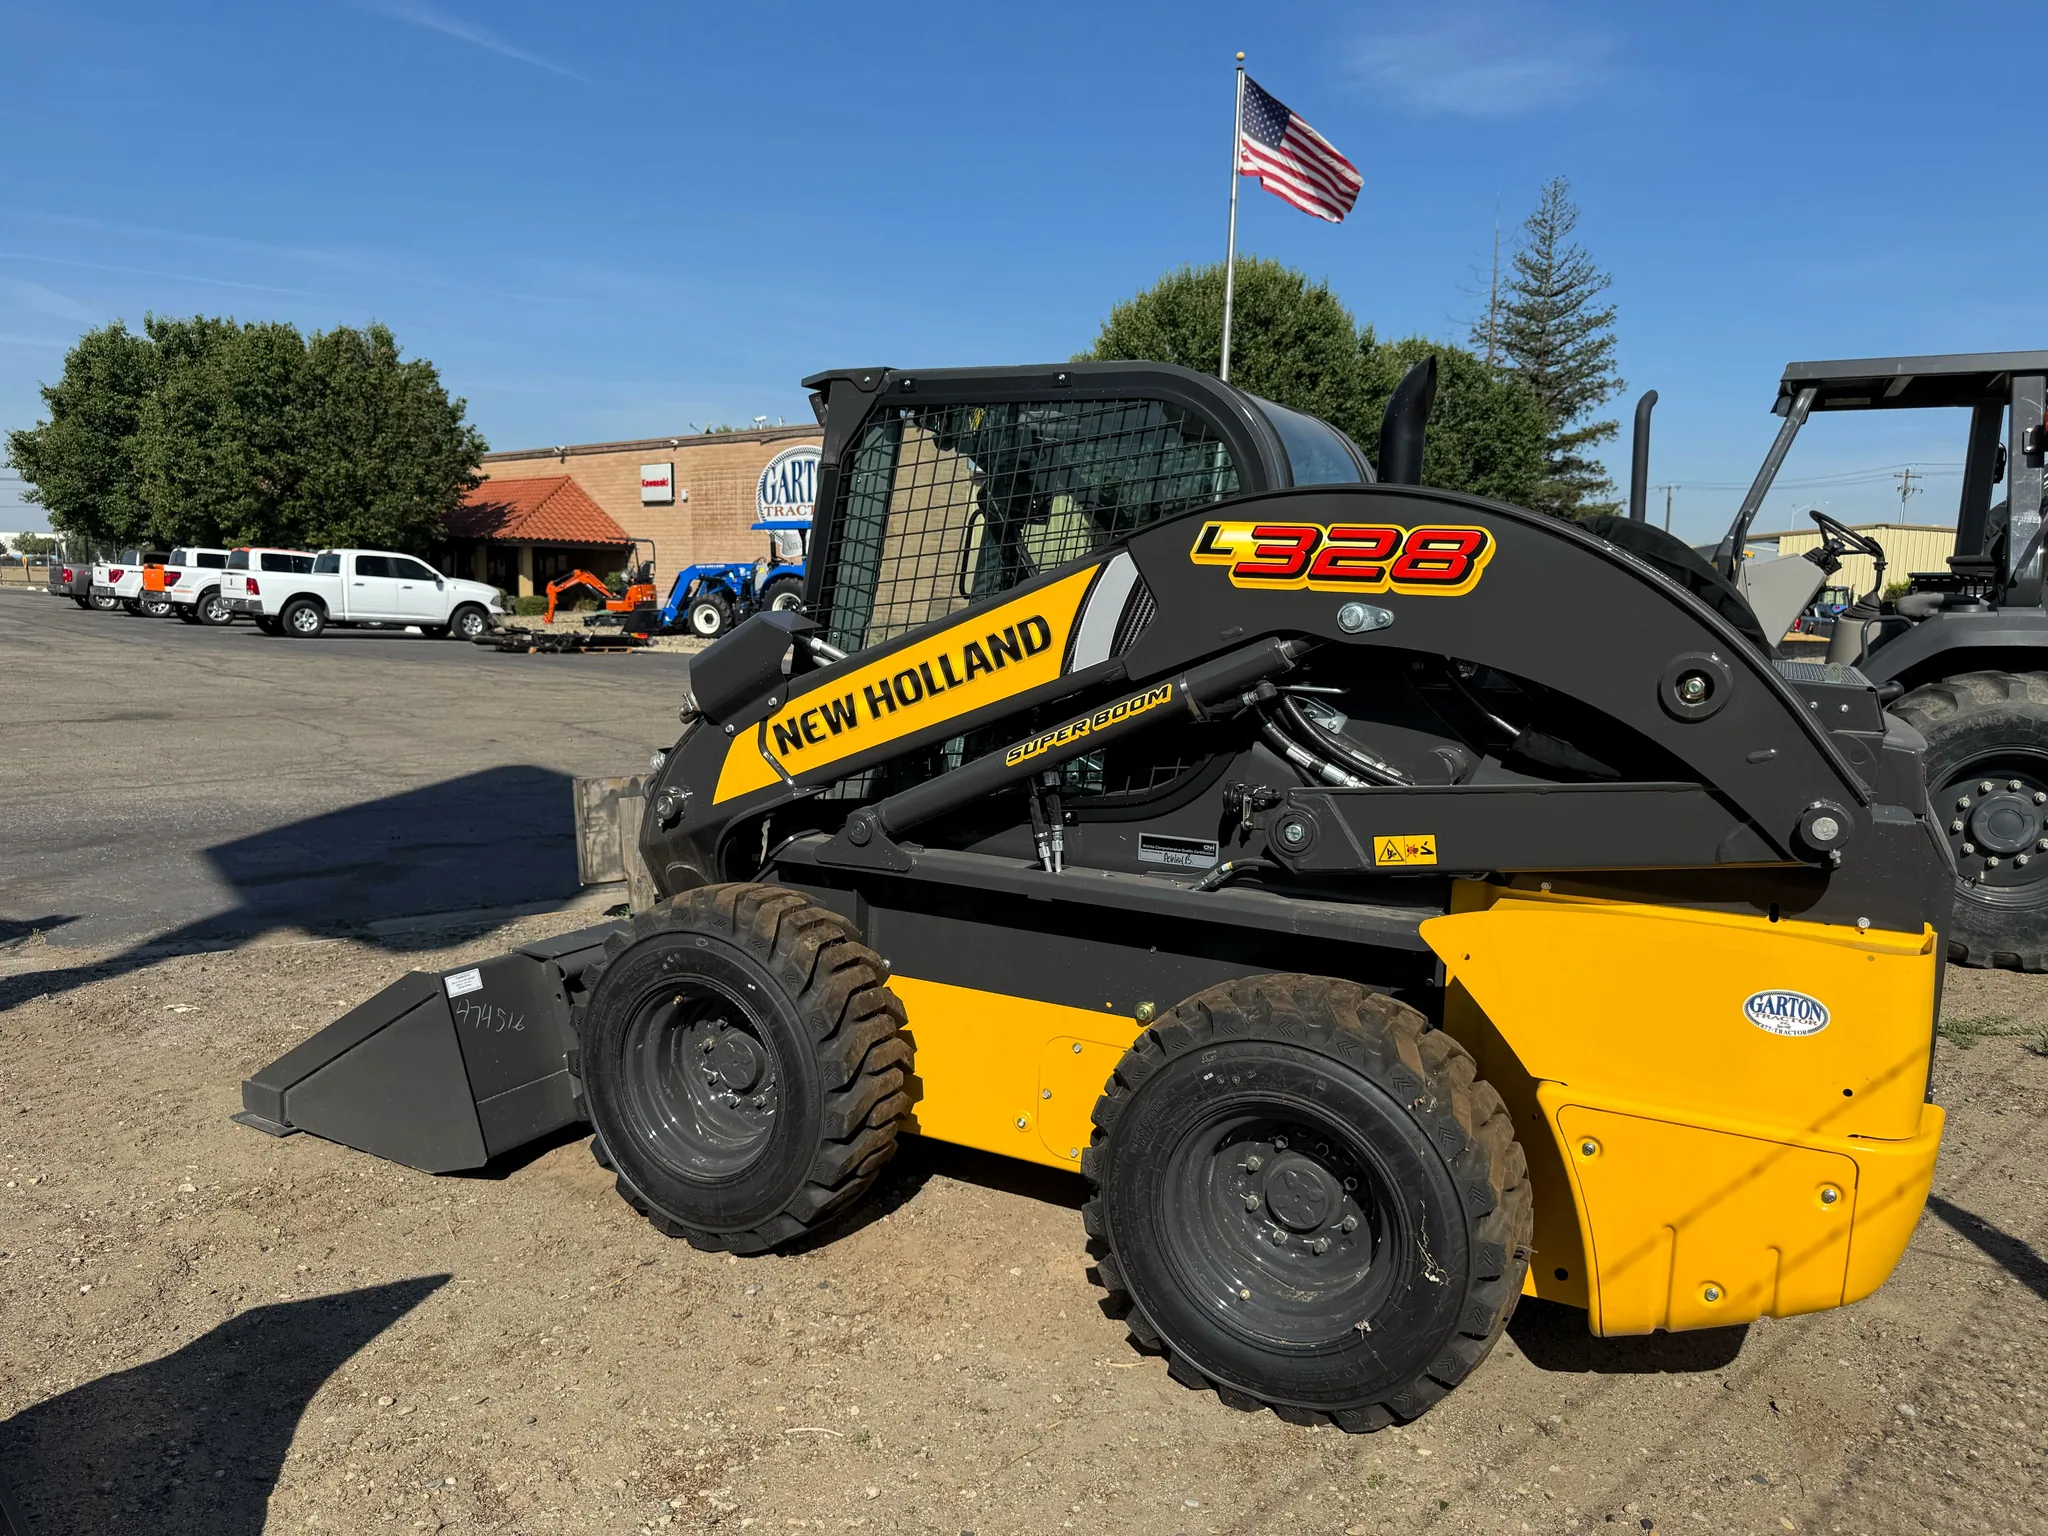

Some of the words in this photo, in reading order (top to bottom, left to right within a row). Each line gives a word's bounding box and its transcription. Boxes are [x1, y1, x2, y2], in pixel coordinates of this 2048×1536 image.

[641, 477, 669, 487] Kawasaki
[762, 459, 820, 505] GART
[1193, 522, 1491, 588] L328
[772, 692, 857, 756] NEW
[863, 614, 1052, 720] HOLLAND
[1006, 718, 1090, 766] SUPER
[1091, 683, 1172, 731] BOOM
[1749, 995, 1821, 1021] GARTON
[1754, 1012, 1818, 1026] TRACTOR
